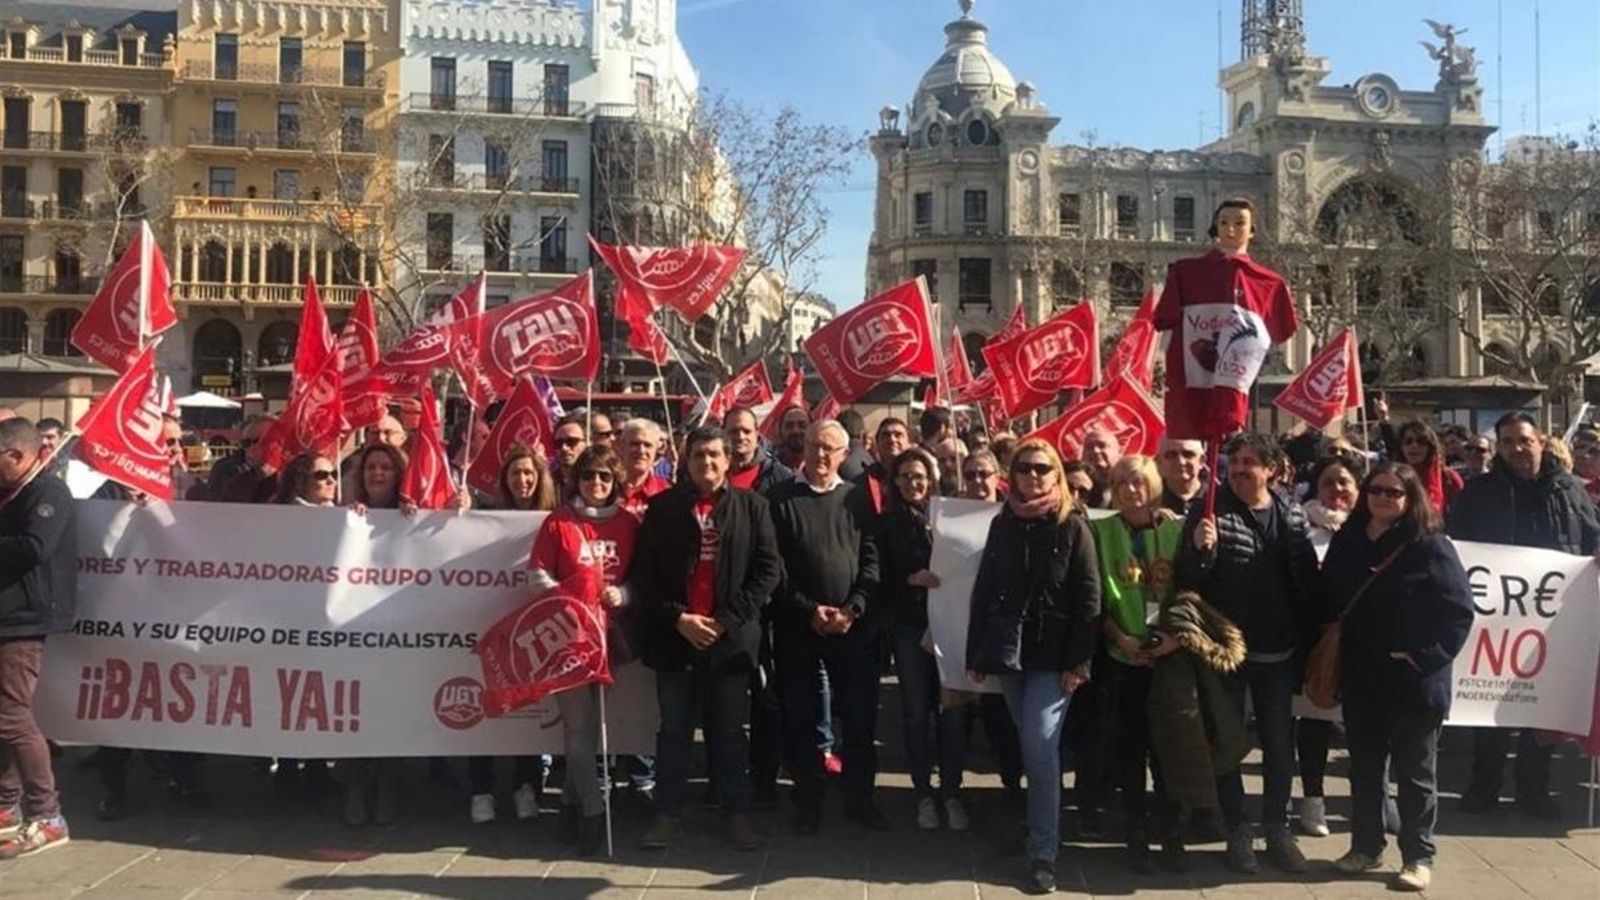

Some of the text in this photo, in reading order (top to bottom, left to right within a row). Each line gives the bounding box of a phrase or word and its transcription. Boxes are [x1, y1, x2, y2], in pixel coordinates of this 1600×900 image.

[847, 307, 908, 358] UGT
[1024, 326, 1075, 372] UGT
[133, 558, 150, 575] Y
[155, 559, 340, 584] TRABAJADORAS
[347, 567, 432, 586] GRUPO
[440, 569, 530, 588] VODAF
[132, 622, 147, 638] Y
[149, 622, 180, 640] SU
[185, 624, 266, 645] EQUIPO
[271, 628, 301, 646] DE
[306, 630, 478, 649] ESPECIALISTAS
[1471, 628, 1547, 679] NO
[276, 667, 362, 733] YA!!
[441, 685, 483, 706] UGT
